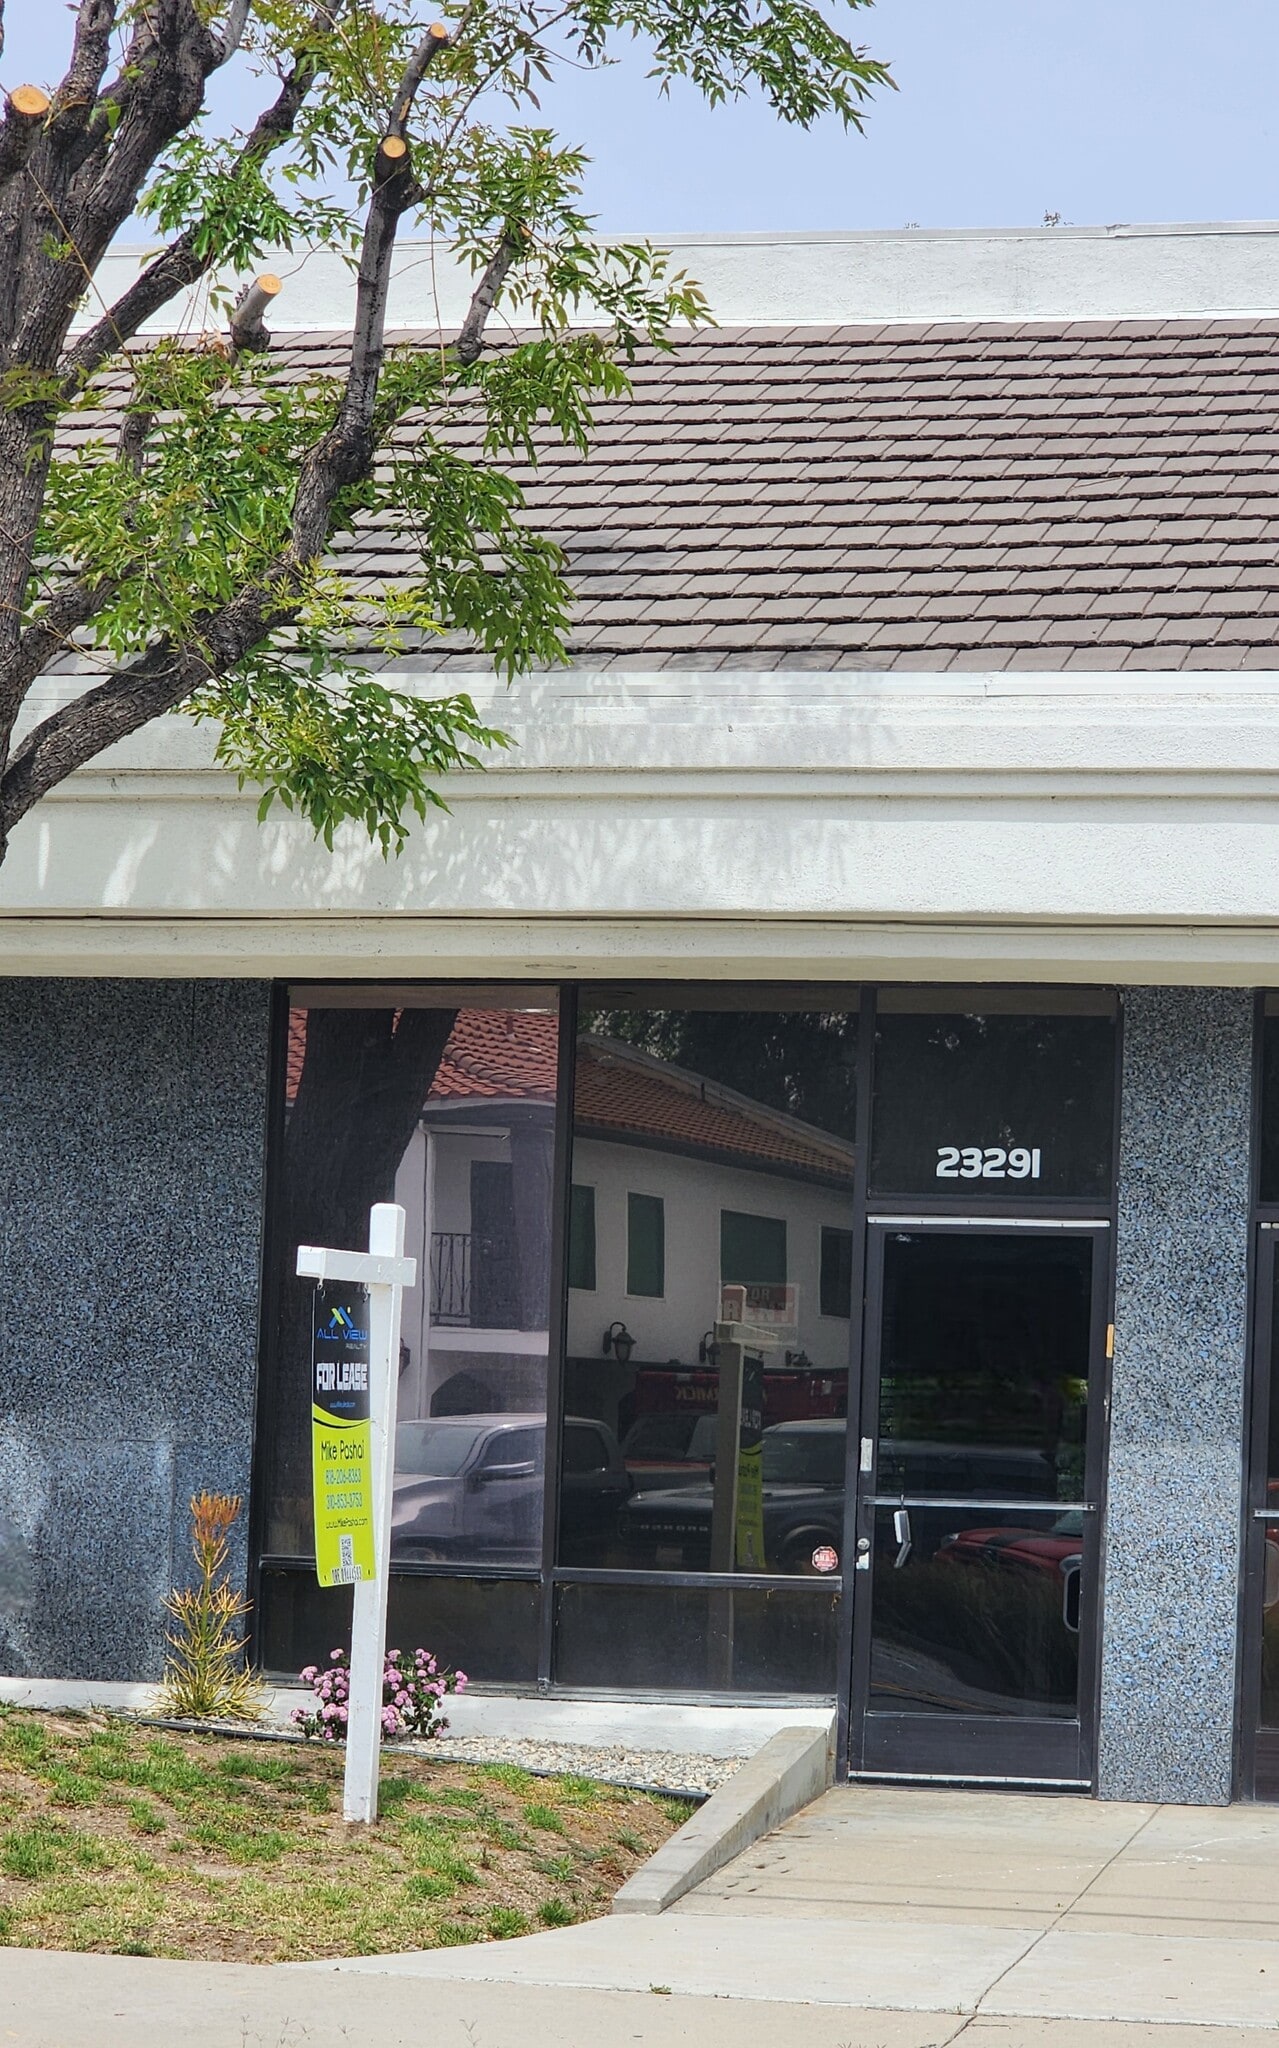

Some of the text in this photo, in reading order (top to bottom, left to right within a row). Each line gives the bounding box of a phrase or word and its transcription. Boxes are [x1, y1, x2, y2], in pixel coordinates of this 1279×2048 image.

[936, 1146, 1041, 1179] 23291
[317, 1328, 368, 1340] ALL VIEW
[316, 1362, 368, 1391] FOR LEASE
[321, 1440, 338, 1461] Mike
